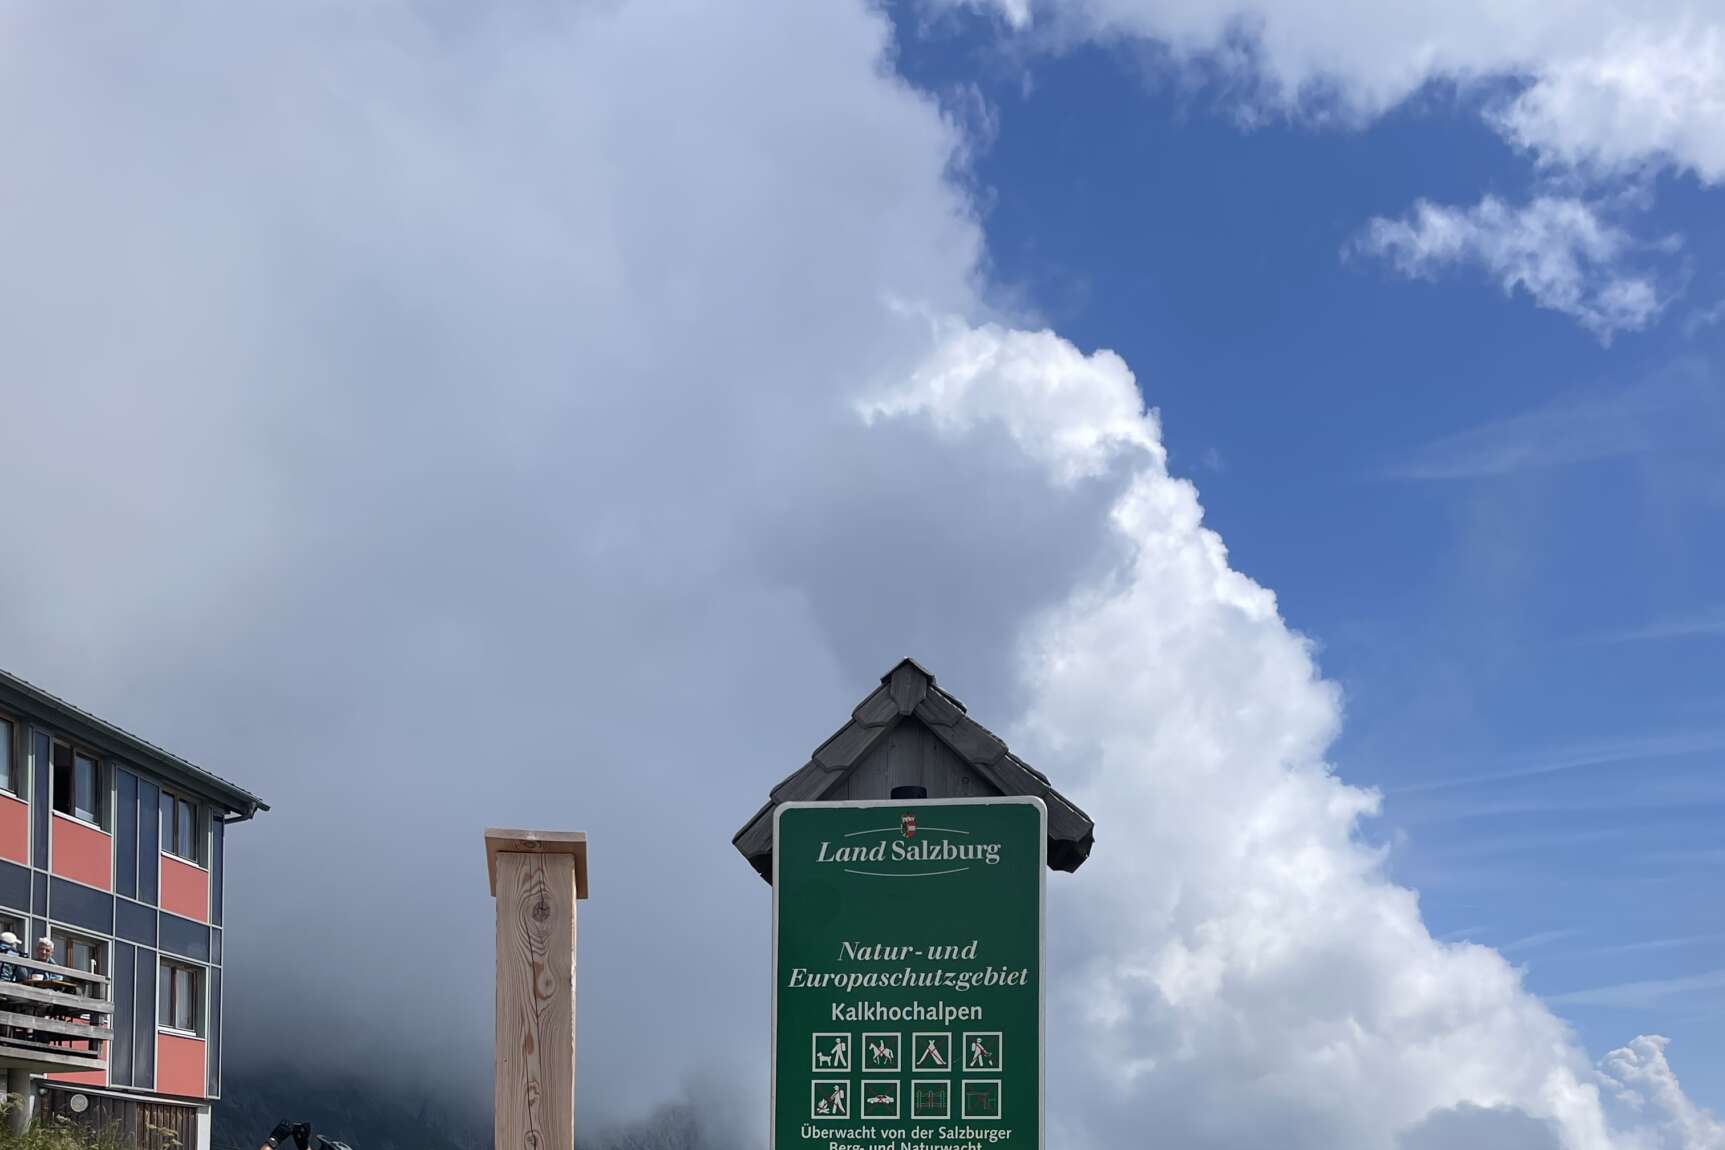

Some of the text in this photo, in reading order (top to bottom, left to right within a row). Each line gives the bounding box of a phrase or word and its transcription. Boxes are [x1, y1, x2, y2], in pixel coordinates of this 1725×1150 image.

[816, 840, 1002, 865] Land Salzburg
[928, 940, 978, 960] und
[788, 966, 1028, 993] Europaschutzgebiet
[831, 1001, 983, 1025] Kalkhochalpen
[801, 1123, 1012, 1142] Überwacht von der Salzburger
